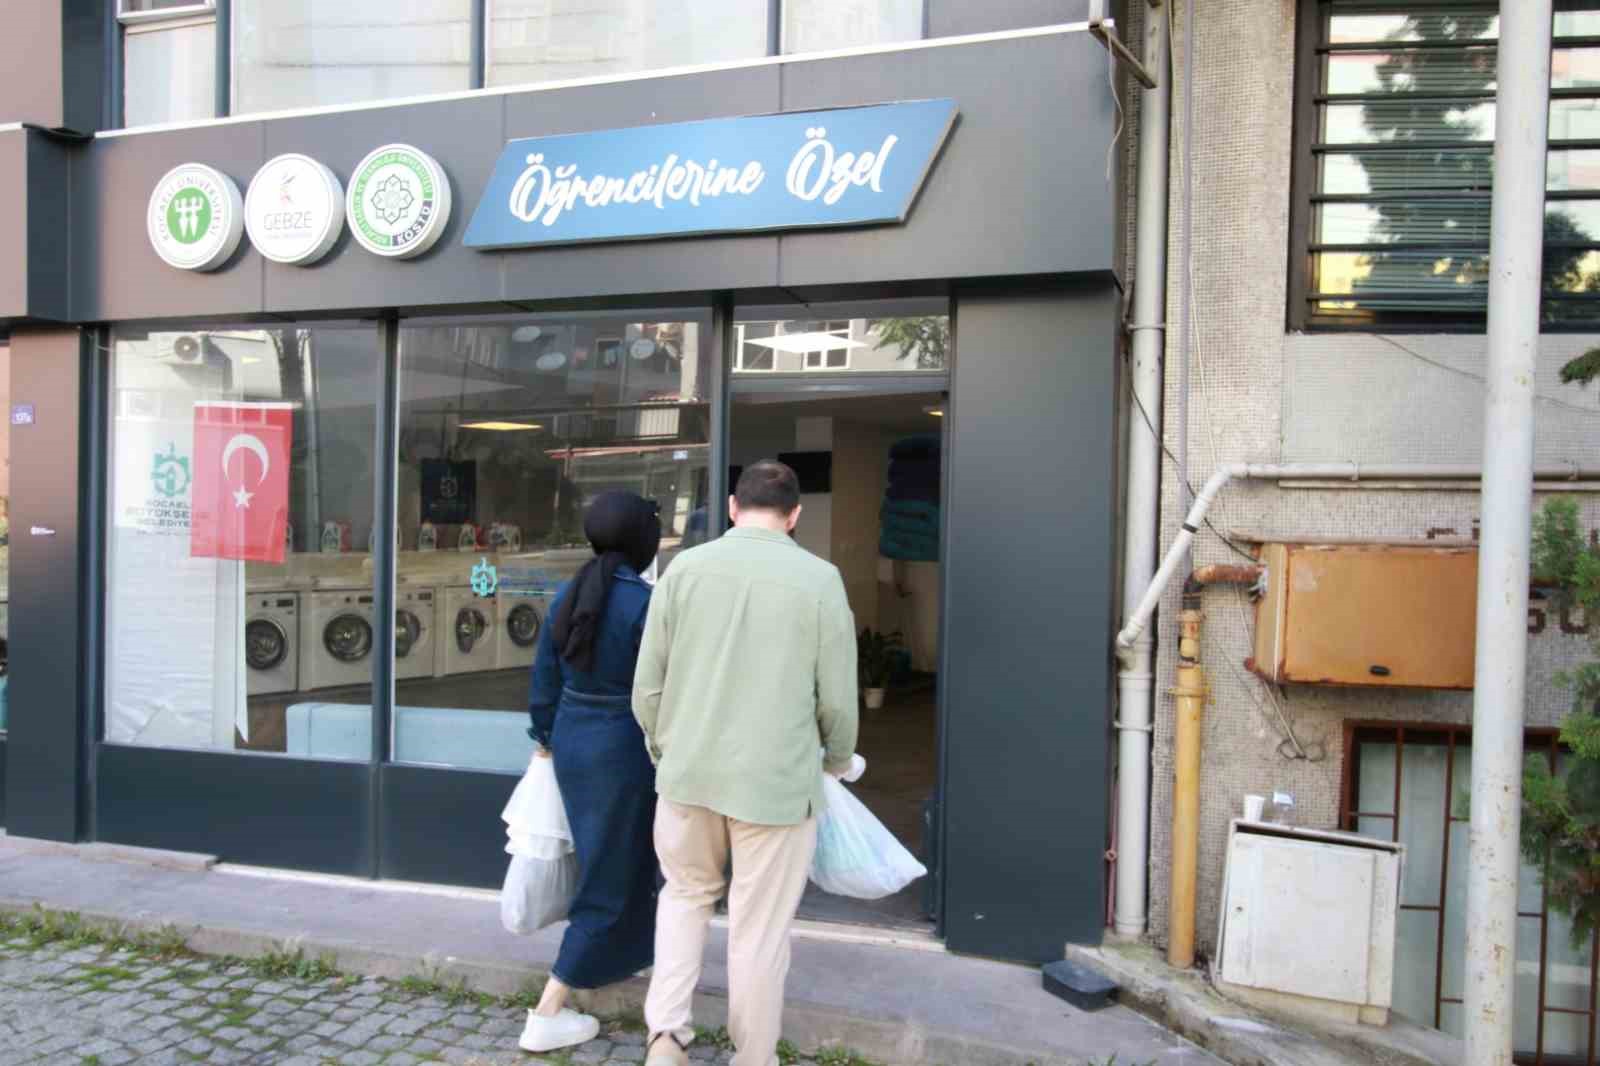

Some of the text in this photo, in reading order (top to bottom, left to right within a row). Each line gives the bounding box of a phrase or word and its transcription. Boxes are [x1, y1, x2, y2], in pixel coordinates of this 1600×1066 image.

[509, 153, 765, 226] Öğrencilerine
[785, 127, 898, 205] Özel
[263, 210, 313, 231] GEBZE
